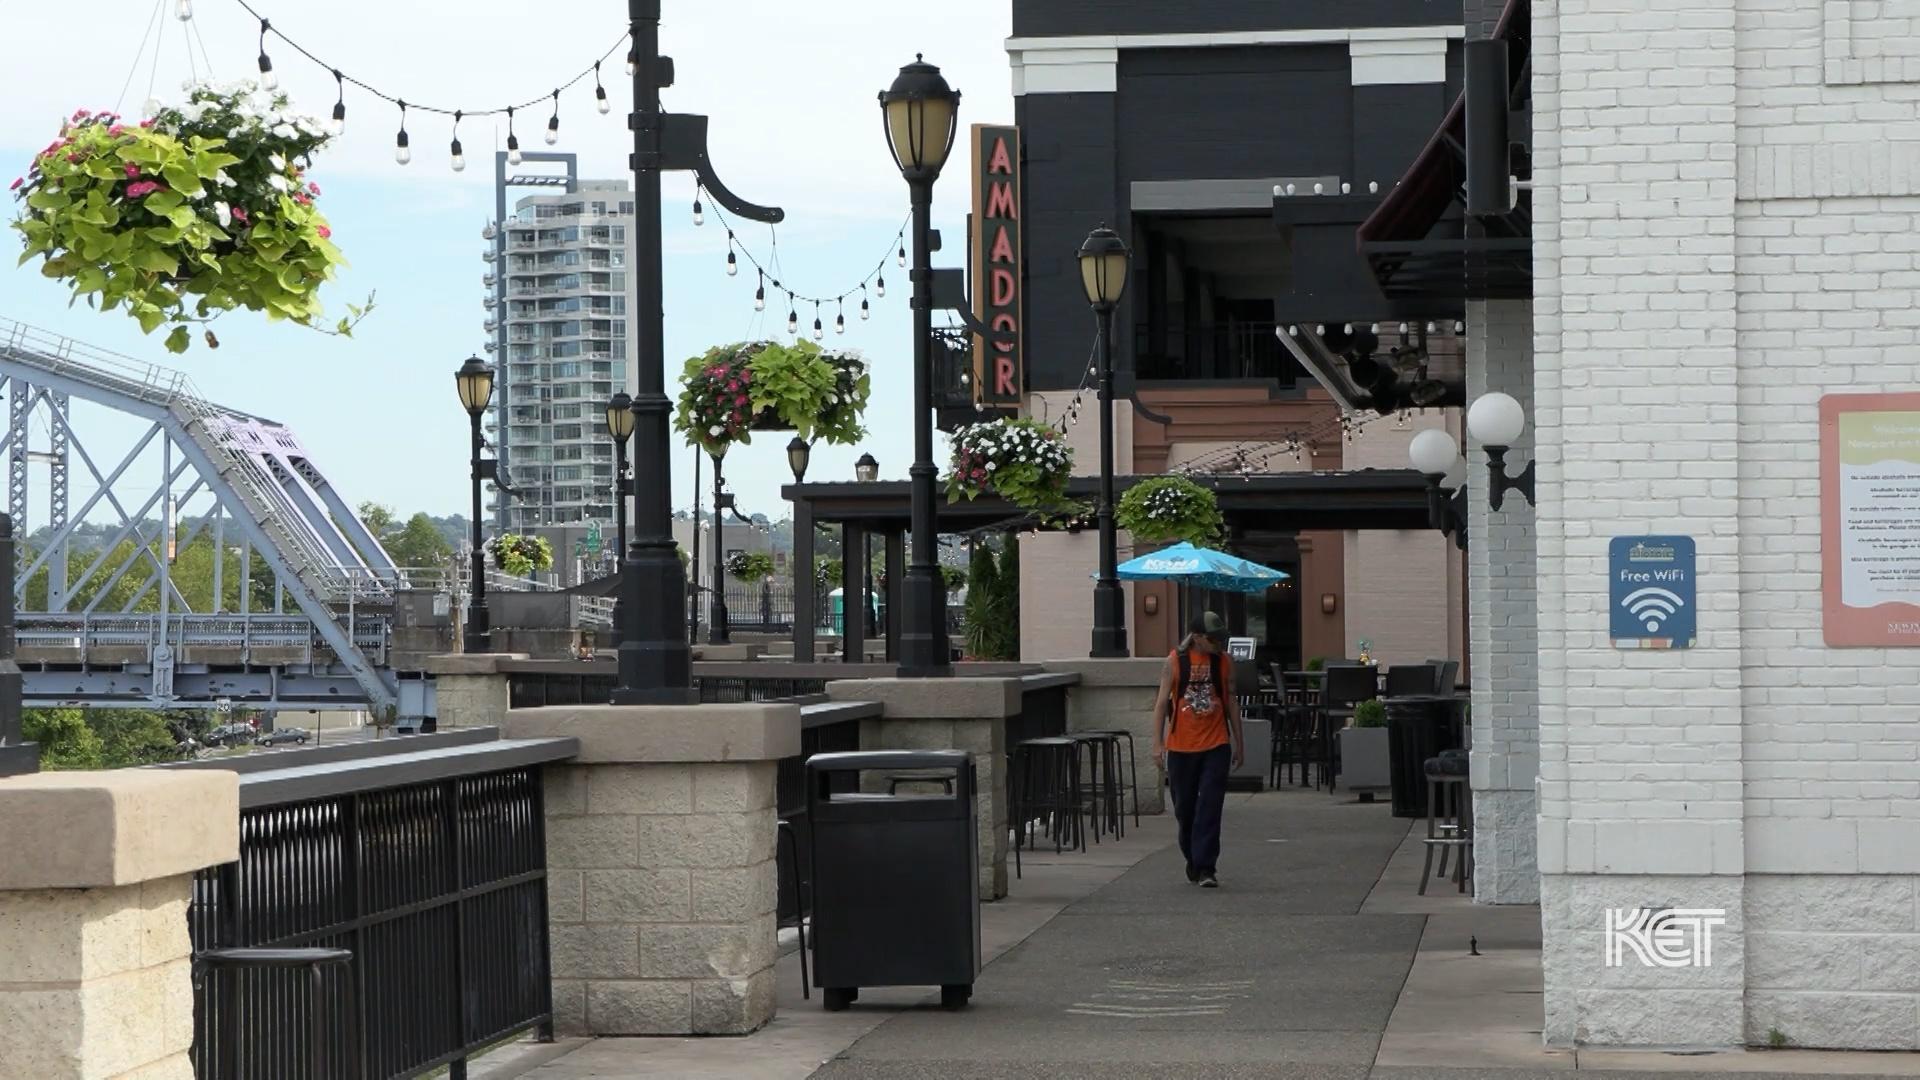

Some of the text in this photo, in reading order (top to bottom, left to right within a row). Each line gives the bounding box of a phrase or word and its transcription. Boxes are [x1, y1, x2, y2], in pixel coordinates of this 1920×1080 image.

[984, 135, 1018, 396] AMADOR
[1620, 568, 1684, 583] Free WiFi
